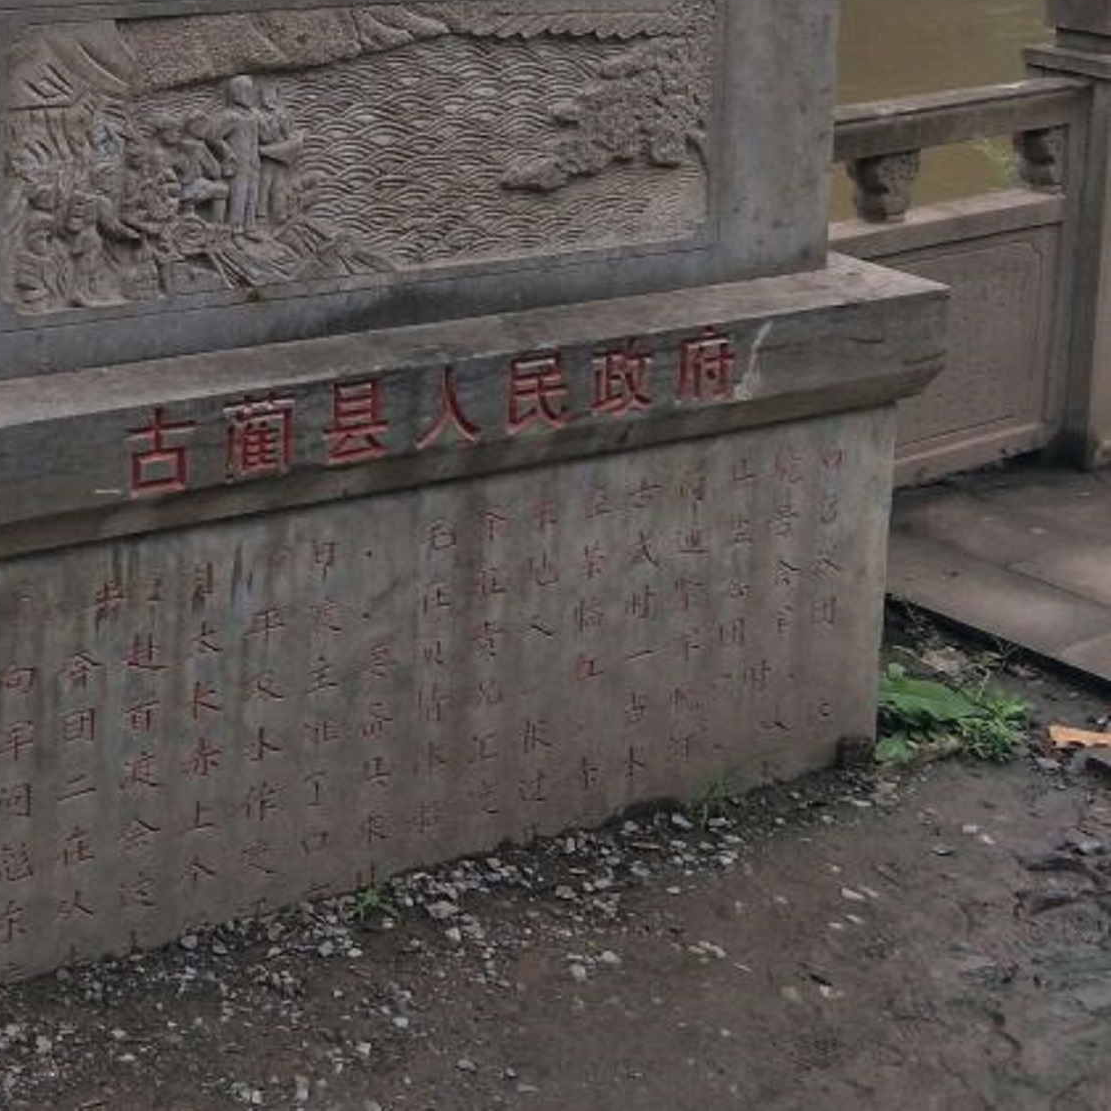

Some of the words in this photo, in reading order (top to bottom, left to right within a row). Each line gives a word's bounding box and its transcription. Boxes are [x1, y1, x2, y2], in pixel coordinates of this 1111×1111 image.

[129, 326, 736, 497] 古蔺县人民政府
